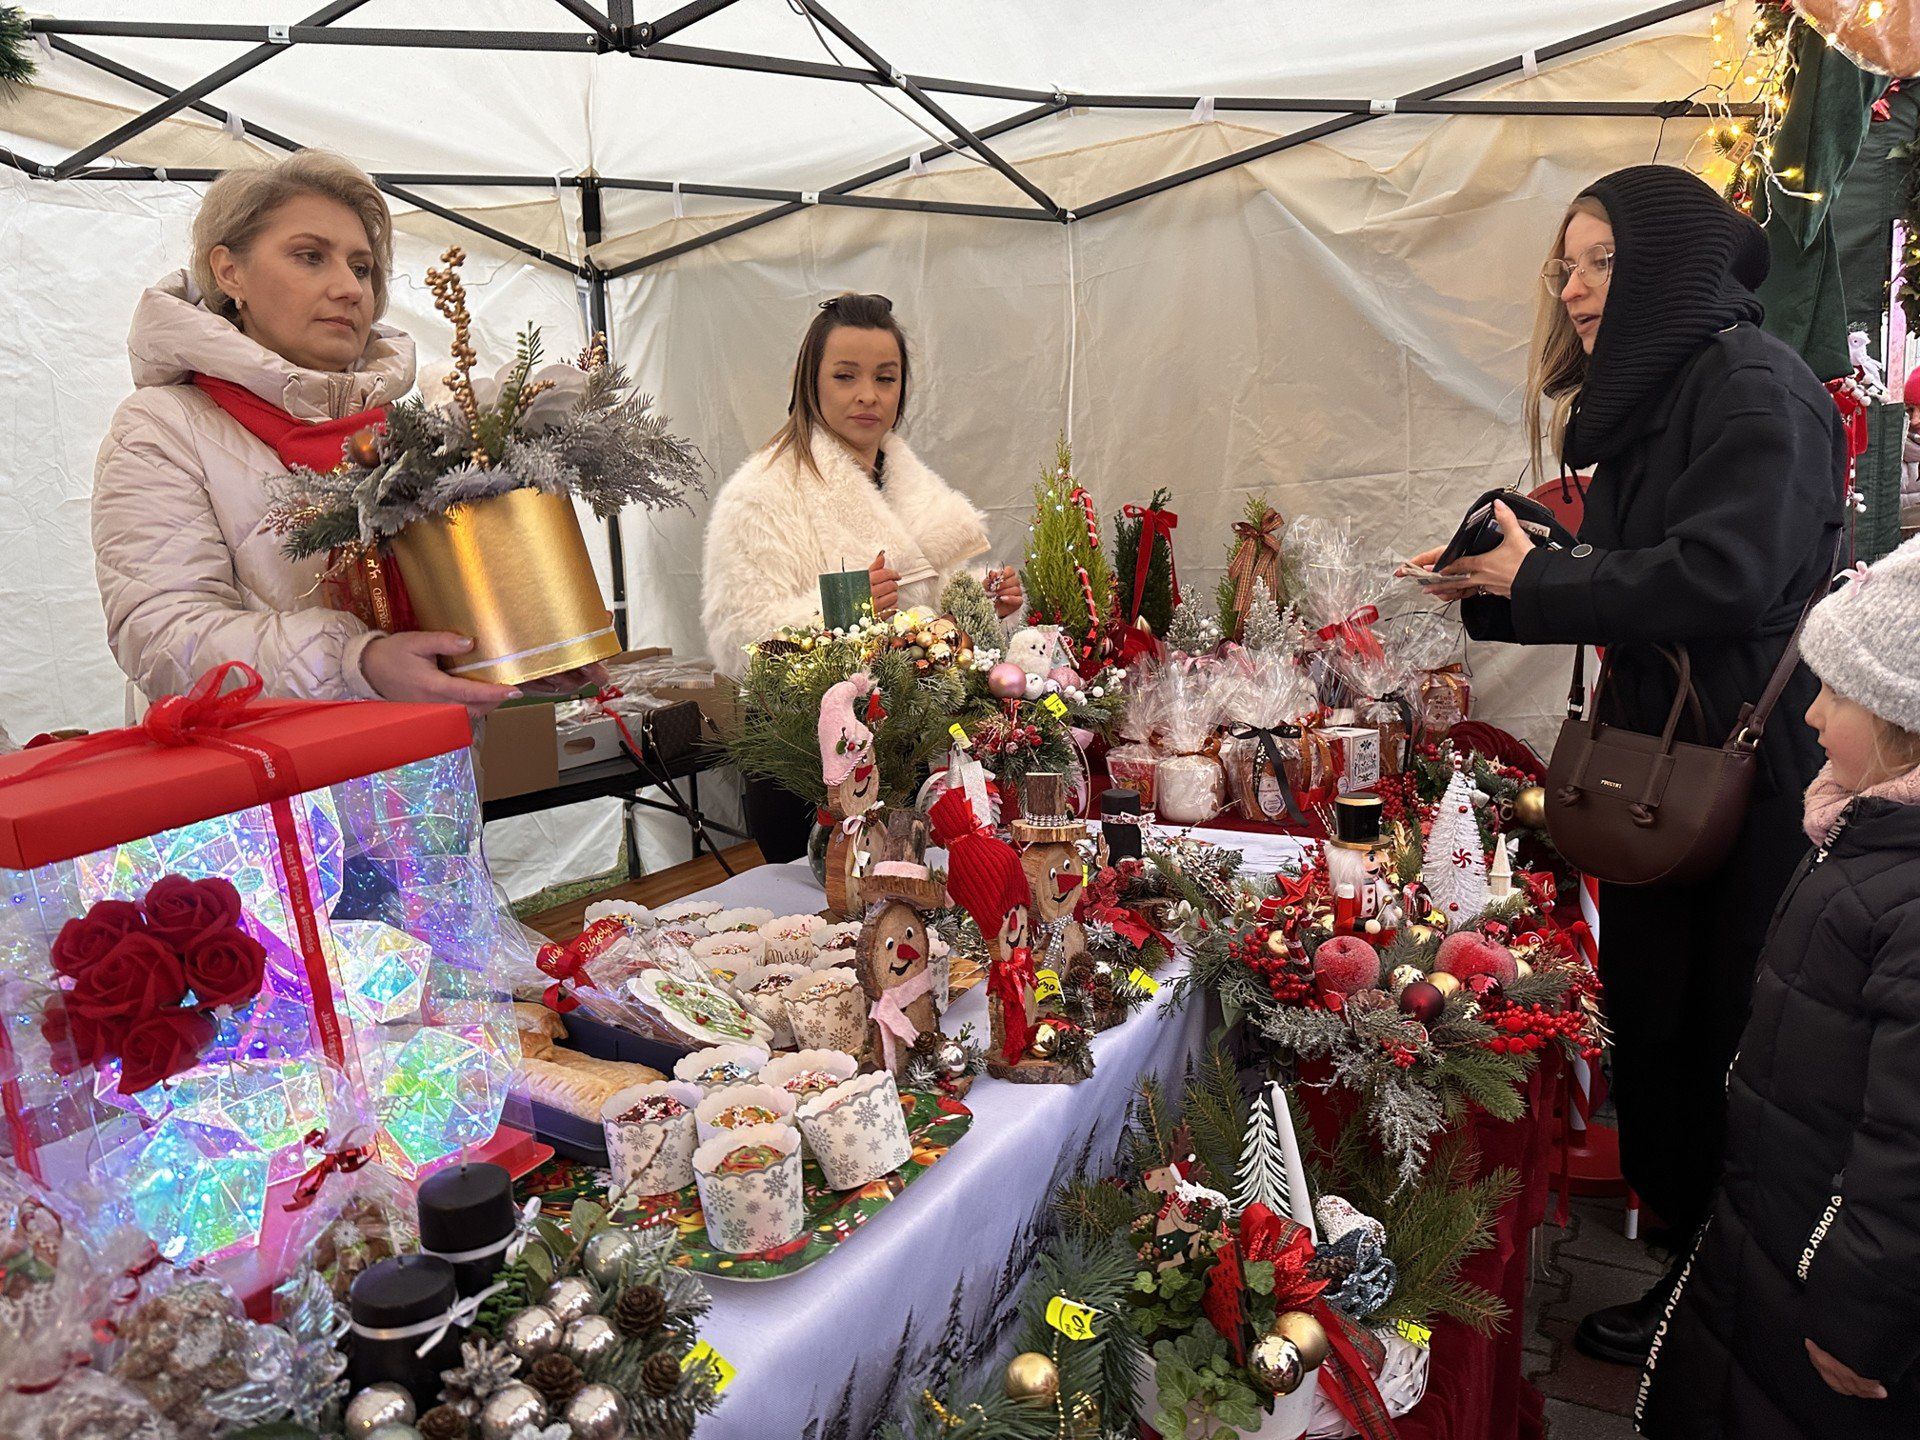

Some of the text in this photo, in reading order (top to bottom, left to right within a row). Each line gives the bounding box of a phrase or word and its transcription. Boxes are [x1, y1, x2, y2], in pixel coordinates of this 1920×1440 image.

[284, 842, 296, 865] Just
[1797, 1205, 1838, 1281] LOVELY DAYS
